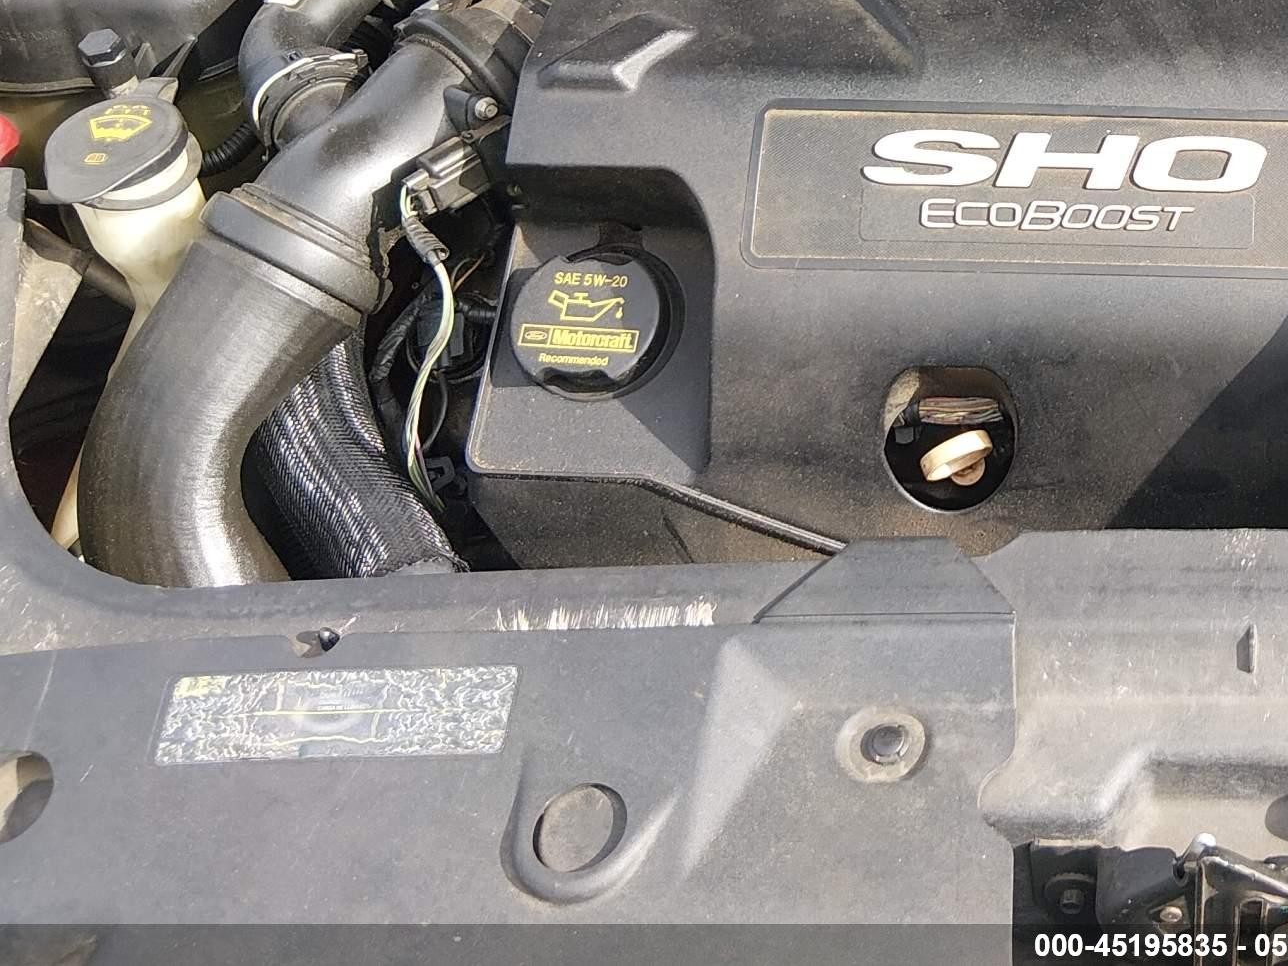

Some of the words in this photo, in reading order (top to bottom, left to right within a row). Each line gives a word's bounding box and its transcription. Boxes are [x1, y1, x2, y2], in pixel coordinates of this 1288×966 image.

[860, 128, 1268, 192] SHO
[554, 271, 582, 285] SAE
[583, 273, 628, 288] 5W-20
[552, 329, 633, 349] Motorcraft
[538, 352, 609, 366] Recommended
